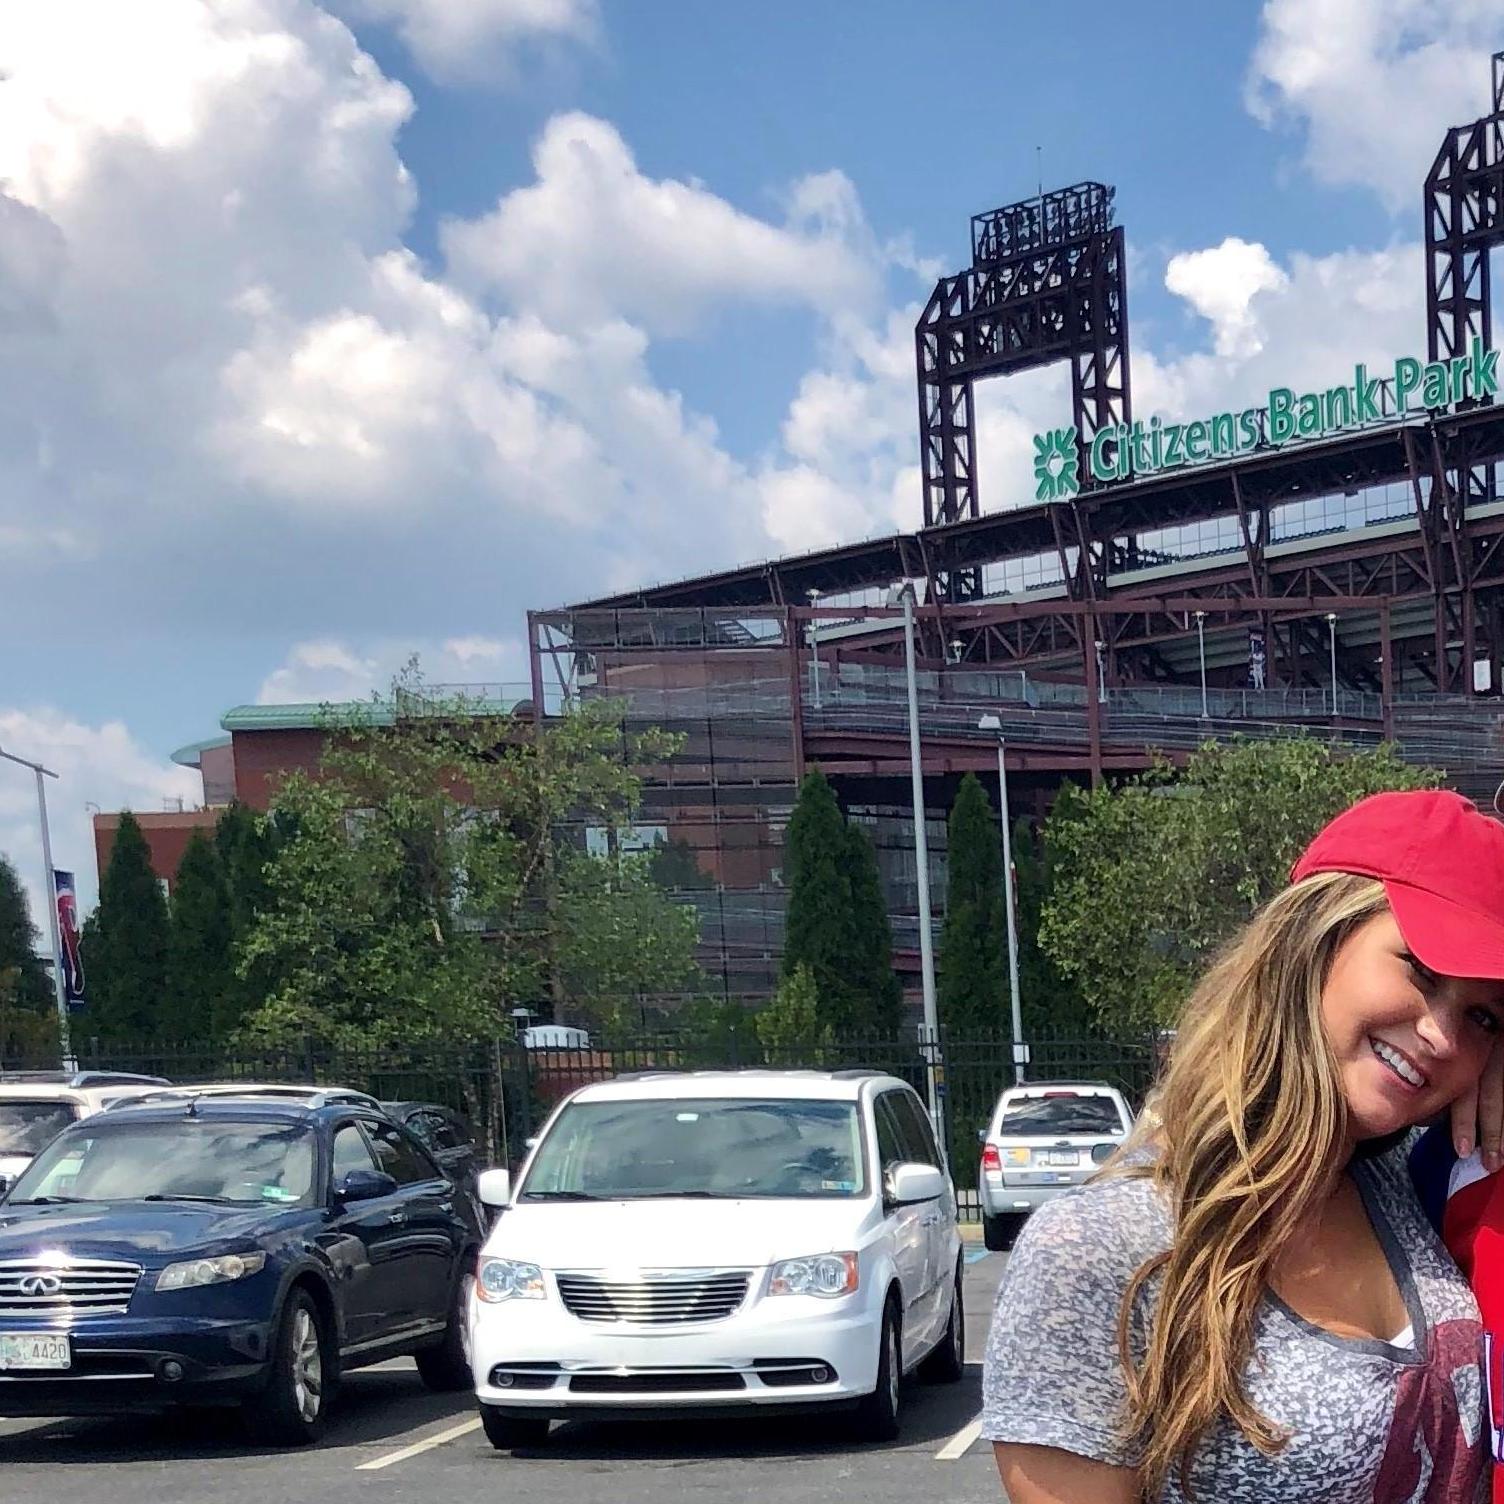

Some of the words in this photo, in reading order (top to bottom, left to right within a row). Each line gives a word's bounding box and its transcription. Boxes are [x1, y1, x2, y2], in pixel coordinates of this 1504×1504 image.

[1090, 414, 1259, 481] Citizens
[1269, 363, 1383, 445] Bank
[1395, 335, 1501, 413] Park
